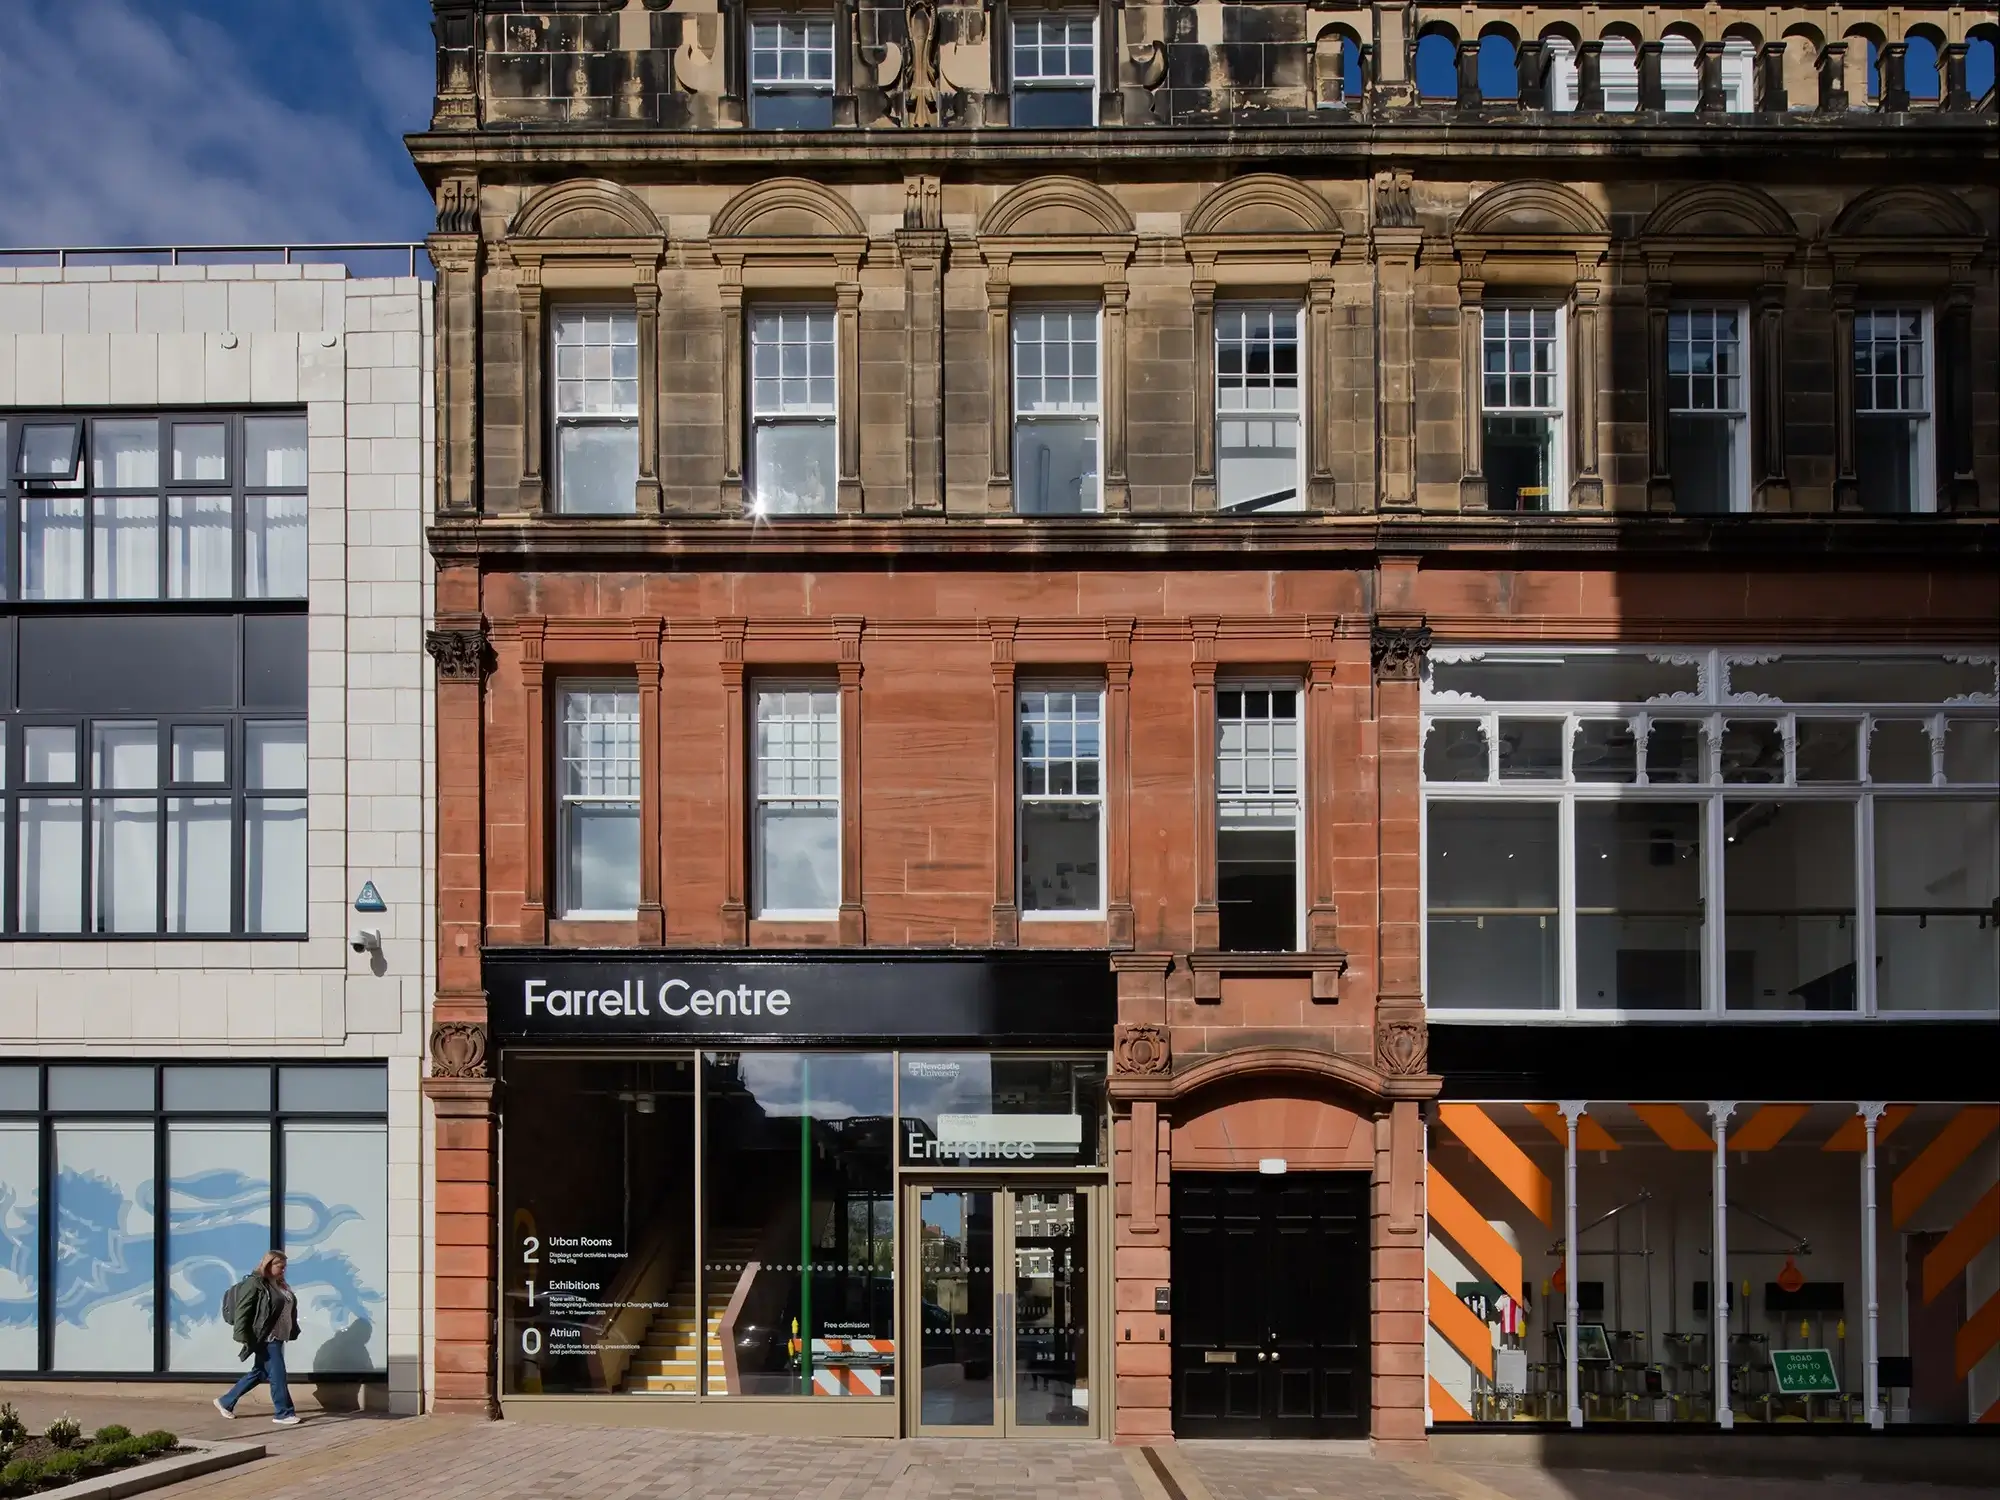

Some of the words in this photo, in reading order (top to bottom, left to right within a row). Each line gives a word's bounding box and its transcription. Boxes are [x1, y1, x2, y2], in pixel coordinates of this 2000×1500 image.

[525, 979, 650, 1016] Farrell
[659, 978, 791, 1016] Centre
[921, 1062, 960, 1070] Newcastle
[921, 1070, 961, 1078] University
[908, 1132, 1035, 1159] Entrance
[523, 1236, 540, 1264] 2
[549, 1236, 578, 1246] Urban
[580, 1236, 613, 1247] Rooms
[525, 1280, 534, 1307] 1
[549, 1280, 600, 1290] Exhibitions
[522, 1327, 541, 1355] 0
[549, 1328, 580, 1337] Atrium
